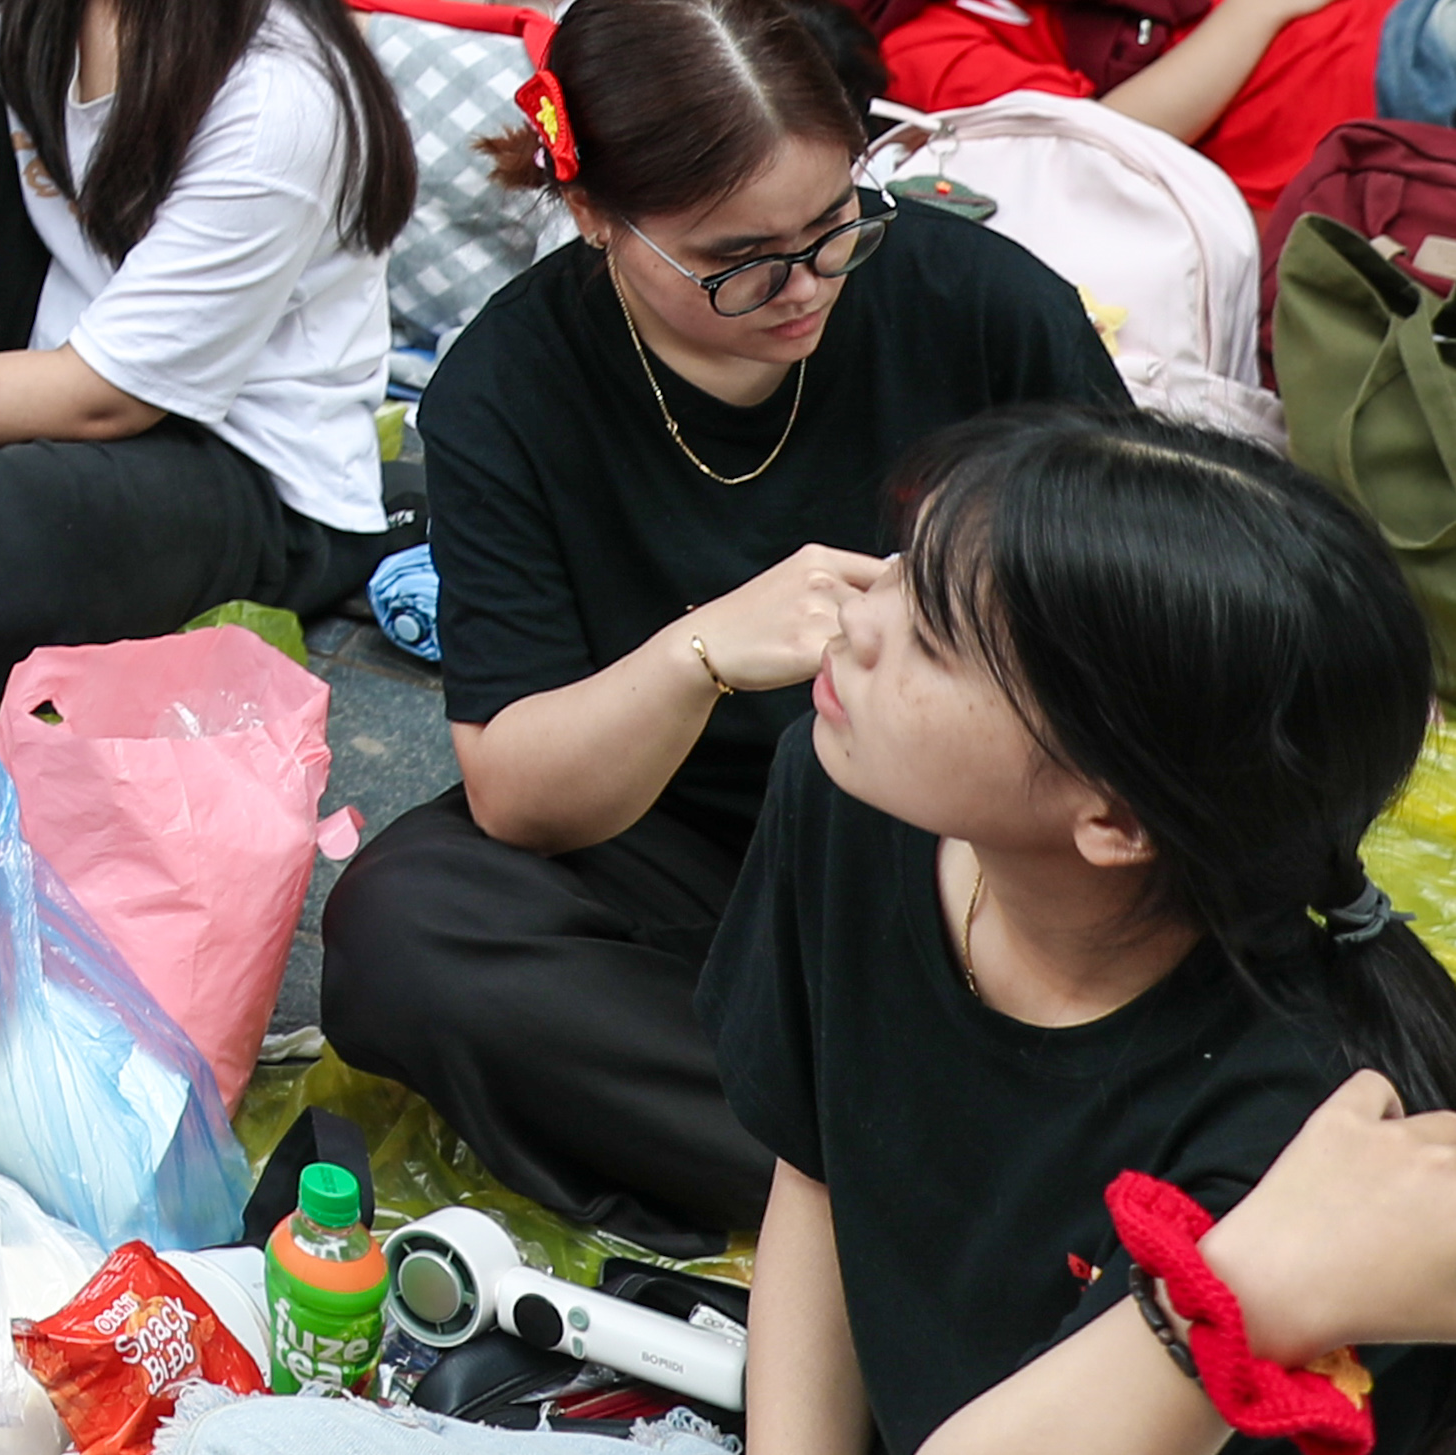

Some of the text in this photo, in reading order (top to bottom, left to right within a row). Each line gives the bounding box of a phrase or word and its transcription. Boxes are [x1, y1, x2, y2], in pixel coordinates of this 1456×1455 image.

[94, 1292, 138, 1335] Oishi
[115, 1295, 197, 1364] Snack
[274, 1297, 369, 1363] fuze
